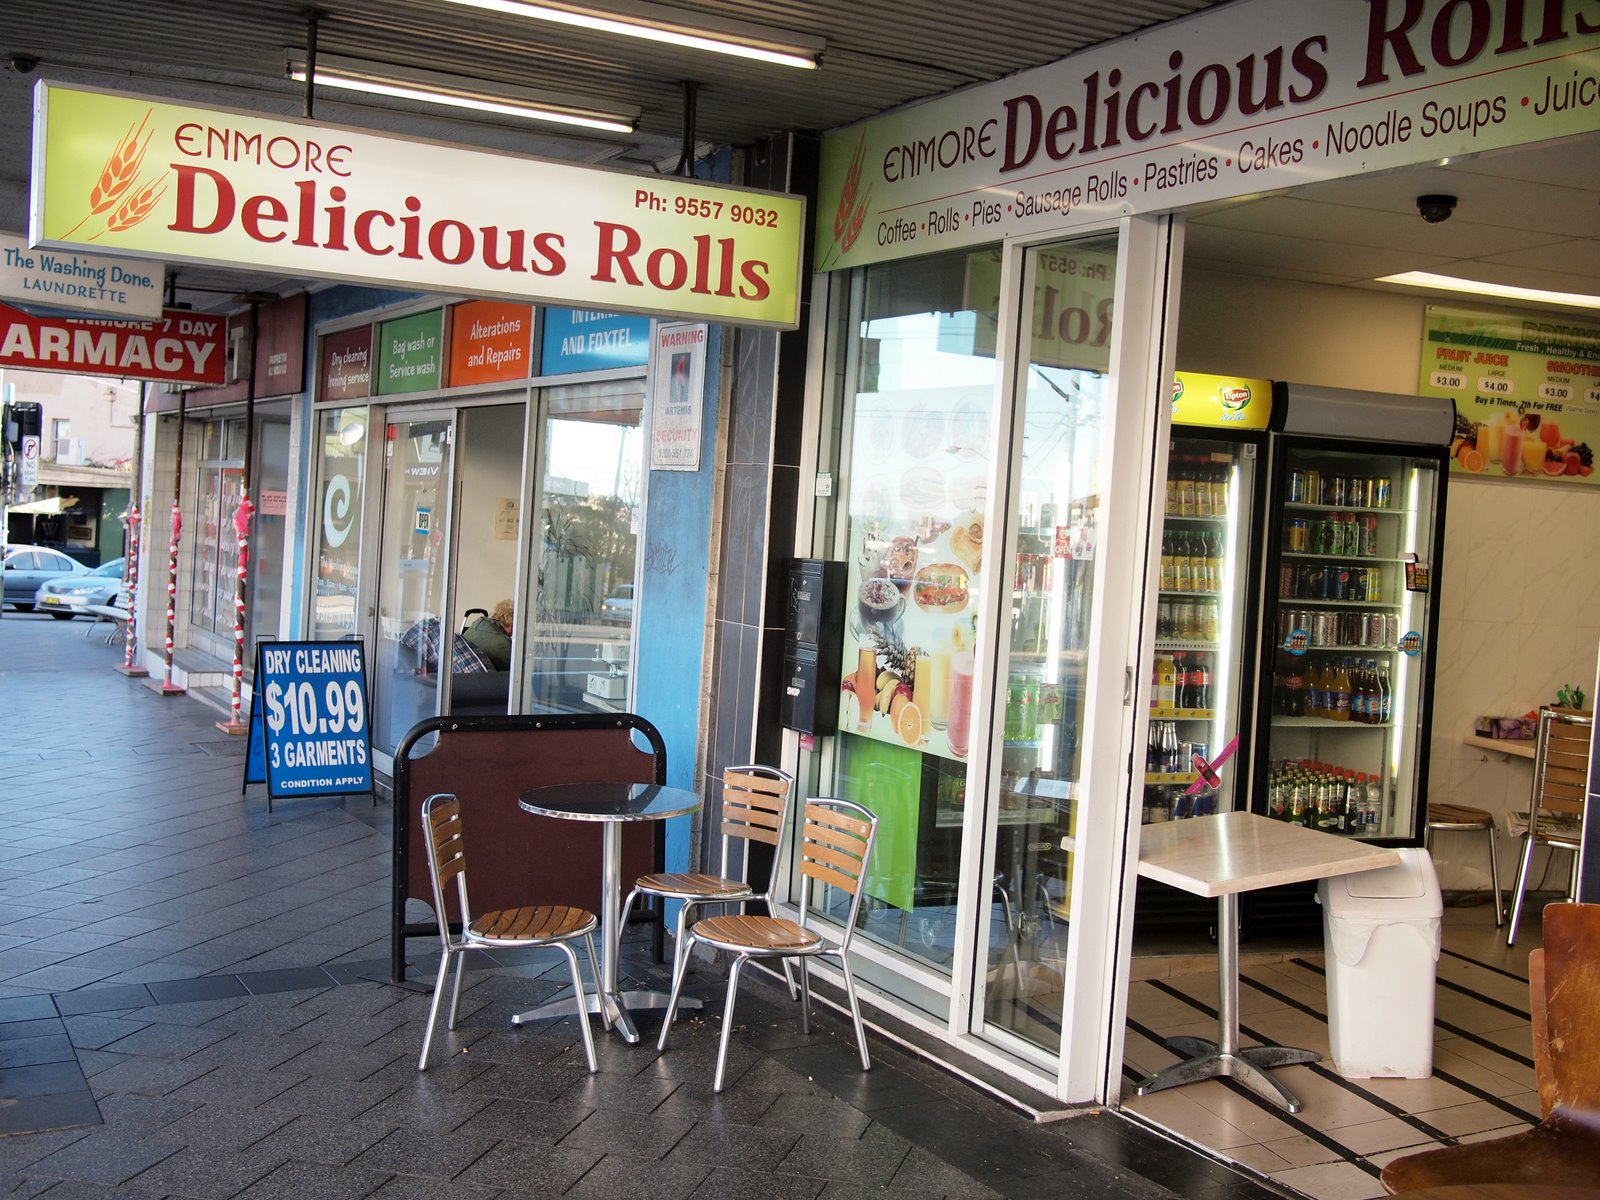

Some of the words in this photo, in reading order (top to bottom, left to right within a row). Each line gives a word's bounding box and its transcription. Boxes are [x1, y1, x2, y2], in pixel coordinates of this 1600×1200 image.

[883, 118, 998, 183] ENMORE
[999, 35, 1329, 174] Delicious
[174, 123, 353, 177] ENMORE
[877, 219, 917, 247] Coffee
[928, 209, 960, 236] Rolls
[972, 200, 1002, 227] Pies
[1014, 185, 1082, 219] Sausage
[1087, 170, 1128, 204] Rolls
[1144, 155, 1218, 192] Pastries
[1237, 137, 1304, 174] Cakes
[1326, 110, 1412, 157] Noodle
[1420, 95, 1507, 137] Soups
[1534, 70, 1600, 116] Juic
[634, 189, 668, 213] Ph:
[674, 196, 724, 220] 9557
[730, 204, 779, 229] 9032
[167, 163, 567, 277] Delicious
[590, 220, 771, 302] Rolls
[4, 248, 35, 269] The
[40, 254, 106, 287] Washing
[110, 266, 155, 289] Done.
[23, 277, 127, 304] LAUNDRETTE
[162, 319, 173, 333] 7
[178, 321, 218, 337] DAY
[470, 316, 521, 340] Alterations
[661, 329, 704, 347] WARNING
[0, 323, 217, 375] ARMACY
[393, 339, 406, 359] Bag
[407, 332, 425, 350] wash
[426, 336, 436, 348] or
[560, 335, 585, 356] AND
[588, 328, 632, 353] FOXTEL
[1516, 342, 1540, 353] Fresh
[1546, 345, 1577, 358] Healthy
[332, 352, 343, 370] Dry
[343, 347, 368, 368] cleaning
[389, 360, 416, 379] Service
[416, 355, 435, 374] wash
[468, 345, 485, 367] and
[486, 342, 522, 371] Repairs
[1436, 347, 1472, 363] FRUIT
[1474, 353, 1509, 367] JUICE
[1439, 363, 1463, 373] MEDIUM
[1487, 369, 1506, 378] LARGE
[327, 371, 347, 392] Ironing
[347, 368, 370, 386] service
[1436, 376, 1461, 387] $3.00
[1484, 381, 1508, 392] $4.00
[1547, 375, 1570, 384] MEDIUM
[1224, 391, 1247, 401] Lipton
[1475, 396, 1489, 405] Buy
[1489, 397, 1495, 405] 6
[1533, 402, 1545, 411] For
[1545, 403, 1563, 412] FREE
[1545, 388, 1568, 399] $3.00
[665, 406, 692, 416] ARTEMIS
[656, 427, 698, 443] SECURITY
[418, 513, 429, 529] OPEN
[1055, 545, 1072, 555] OPEN
[265, 650, 291, 674] DRY
[296, 649, 361, 673] CLEANING
[786, 686, 801, 697] SHOP
[265, 680, 365, 737] $10.99
[270, 742, 281, 768] 3
[284, 739, 366, 768] GARMENTS
[281, 778, 333, 789] CONDITION
[335, 776, 364, 786] APPLY
